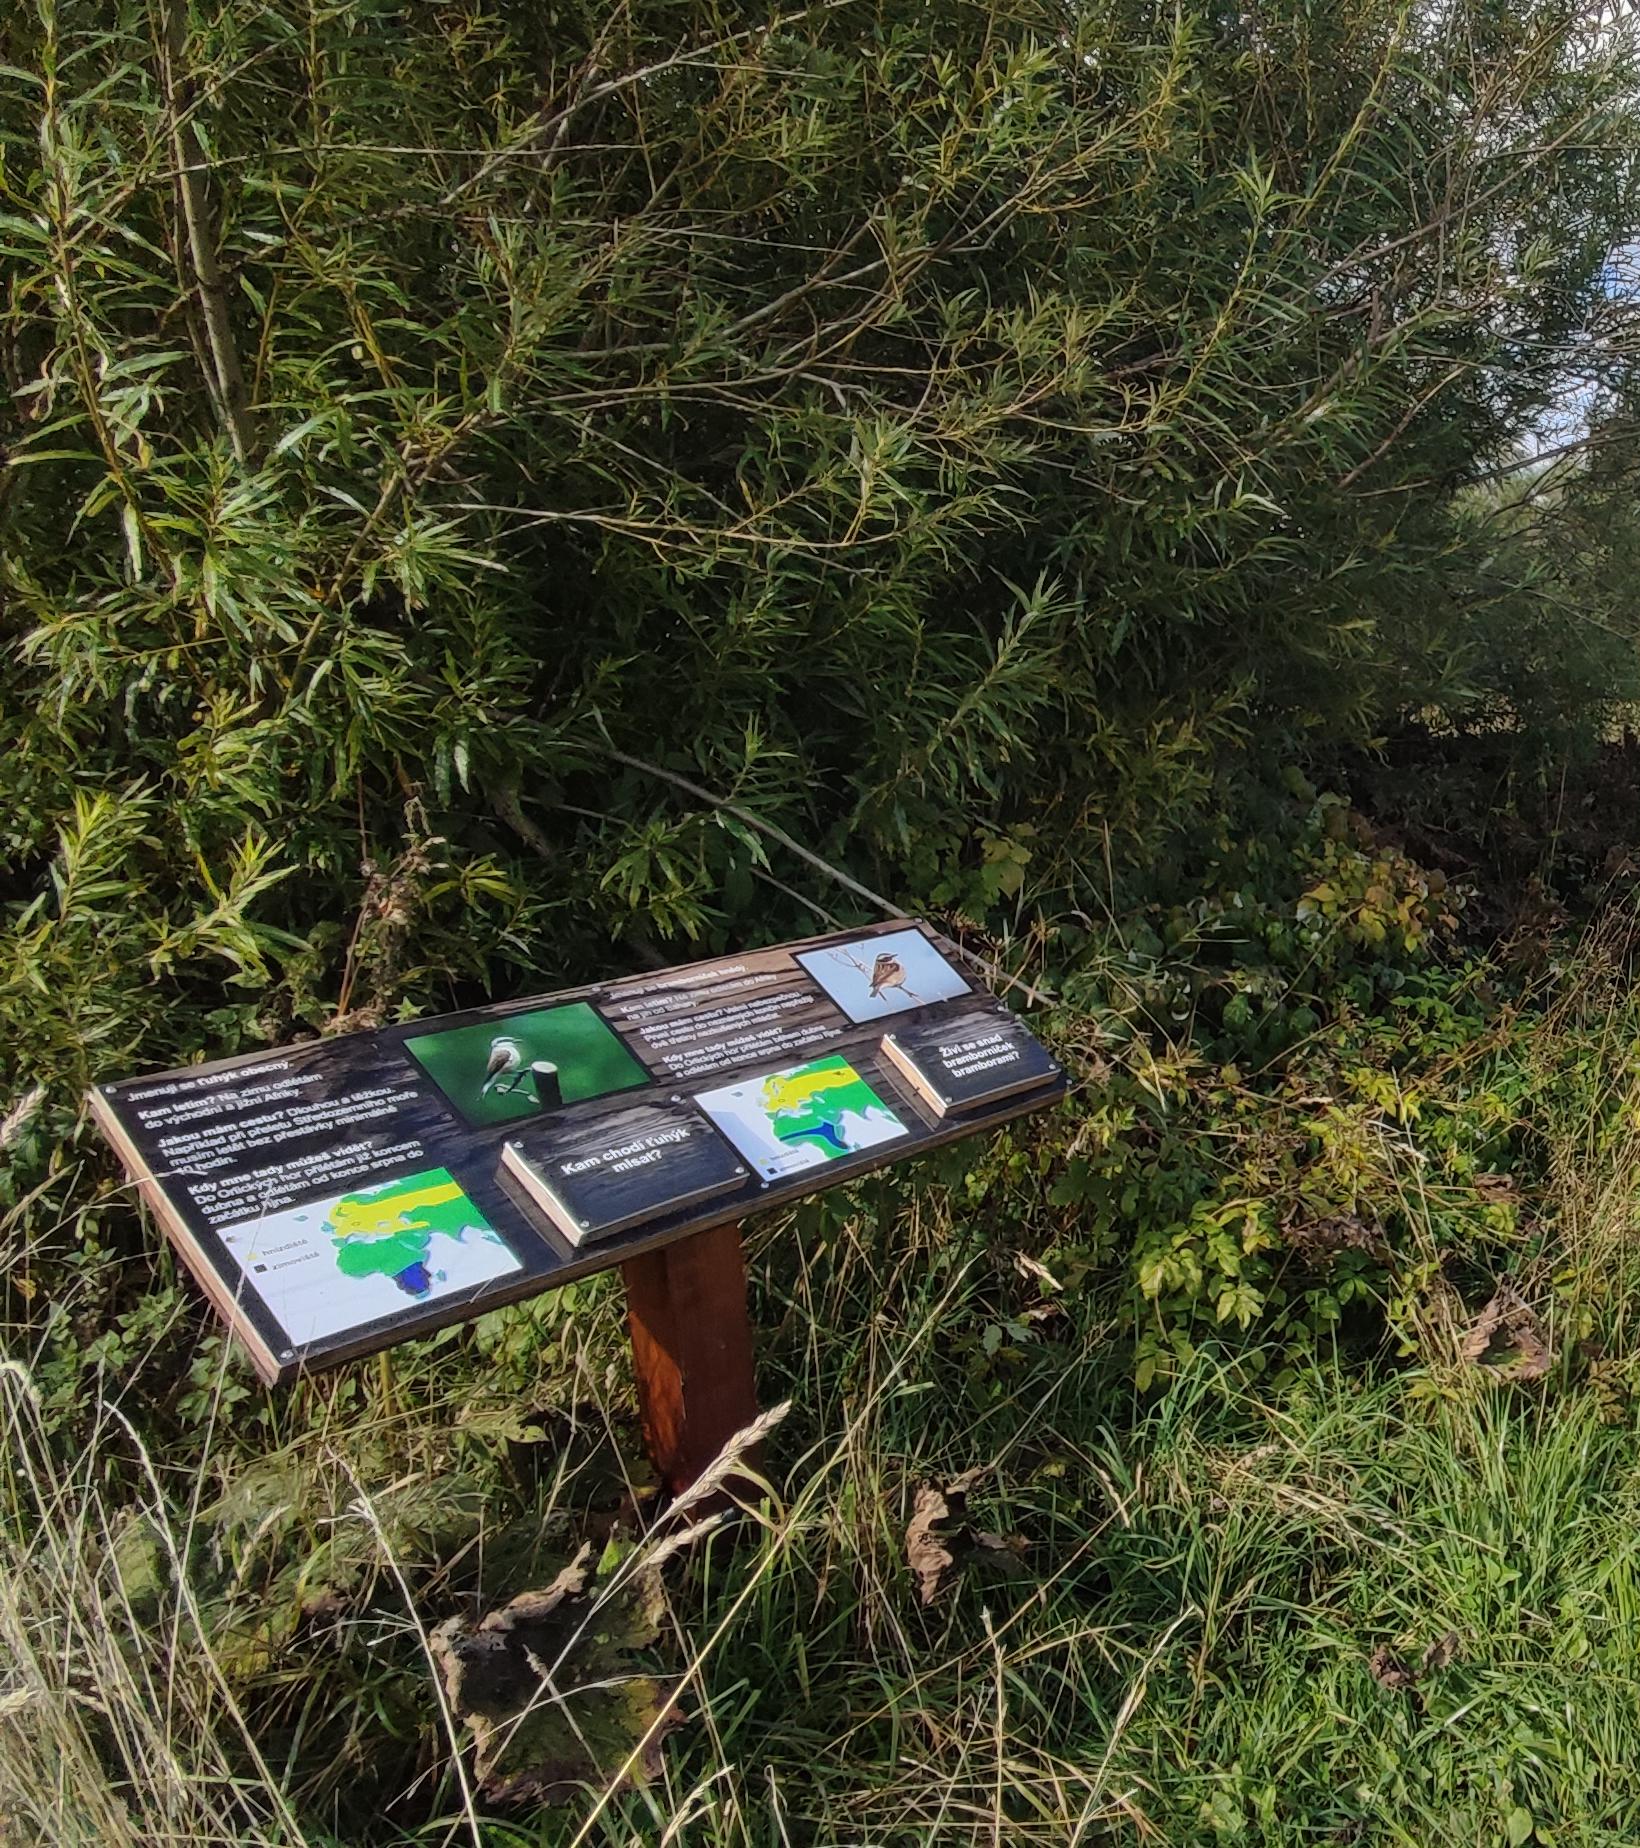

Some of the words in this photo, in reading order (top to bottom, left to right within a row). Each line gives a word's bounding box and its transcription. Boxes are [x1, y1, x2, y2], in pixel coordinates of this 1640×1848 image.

[619, 1004, 644, 1012] Kam
[640, 1023, 669, 1034] Jakou
[668, 1018, 692, 1027] mám
[693, 1009, 722, 1021] cestu?
[669, 1026, 694, 1035] cestu
[661, 1053, 682, 1063] Kdy
[683, 1048, 705, 1057] mne
[704, 1043, 725, 1052] tady
[726, 1034, 756, 1046] můžeš
[668, 1062, 684, 1070] Do
[683, 1051, 724, 1066] Orlických
[723, 1047, 738, 1055] hor
[938, 1044, 962, 1057] Živí
[961, 1042, 976, 1050] se
[976, 1033, 1002, 1046] snad
[942, 1042, 1014, 1067] bramborníček
[683, 1062, 719, 1075] odlétám
[718, 1058, 731, 1066] od
[730, 1051, 757, 1062] konce
[951, 1051, 1019, 1077] bramborami?
[128, 1084, 177, 1101] Jmenuji
[179, 1081, 195, 1089] se
[196, 1071, 238, 1085] ťuhýk
[137, 1107, 171, 1119] Kam
[172, 1096, 214, 1111] letím?
[216, 1092, 238, 1101] Na
[240, 1085, 271, 1096] zimu
[272, 1074, 322, 1089] odlétám
[144, 1120, 163, 1128] do
[164, 1104, 222, 1124] východní
[233, 1095, 262, 1109] jižní
[264, 1088, 302, 1101] Afriky.
[158, 1132, 200, 1147] Jakou
[202, 1123, 237, 1136] mám
[239, 1111, 283, 1127] cestu?
[286, 1100, 339, 1116] Dlouhou
[162, 1135, 226, 1156] Například
[227, 1131, 246, 1142] při
[247, 1121, 291, 1137] přeletu
[293, 1099, 385, 1124] Středozemního
[386, 1091, 417, 1102] moře
[169, 1150, 214, 1166] musím
[215, 1142, 245, 1154] letět
[245, 1136, 272, 1147] bez
[273, 1121, 332, 1142] přestávky
[335, 1105, 396, 1124] minimálně
[194, 1156, 236, 1171] hodin.
[561, 1157, 600, 1174] Kam
[602, 1140, 645, 1160] chodí
[644, 1128, 689, 1146] ťuhýk
[612, 1149, 661, 1171] mlsat?
[187, 1182, 216, 1194] Kdy
[220, 1174, 251, 1186] mne
[252, 1165, 283, 1177] tady
[286, 1151, 330, 1169] můžeš
[332, 1140, 372, 1156] vidět?
[194, 1194, 216, 1204] Do
[217, 1177, 278, 1197] Orlických
[278, 1171, 301, 1181] hor
[304, 1157, 354, 1176] přilétám
[355, 1151, 371, 1162] již
[371, 1140, 420, 1157] koncem
[201, 1198, 244, 1214] dubna
[258, 1180, 310, 1198] odlétám
[311, 1173, 329, 1184] od
[329, 1164, 369, 1178] konce
[370, 1154, 405, 1168] srpna
[406, 1150, 423, 1158] do
[208, 1204, 260, 1223] začátku
